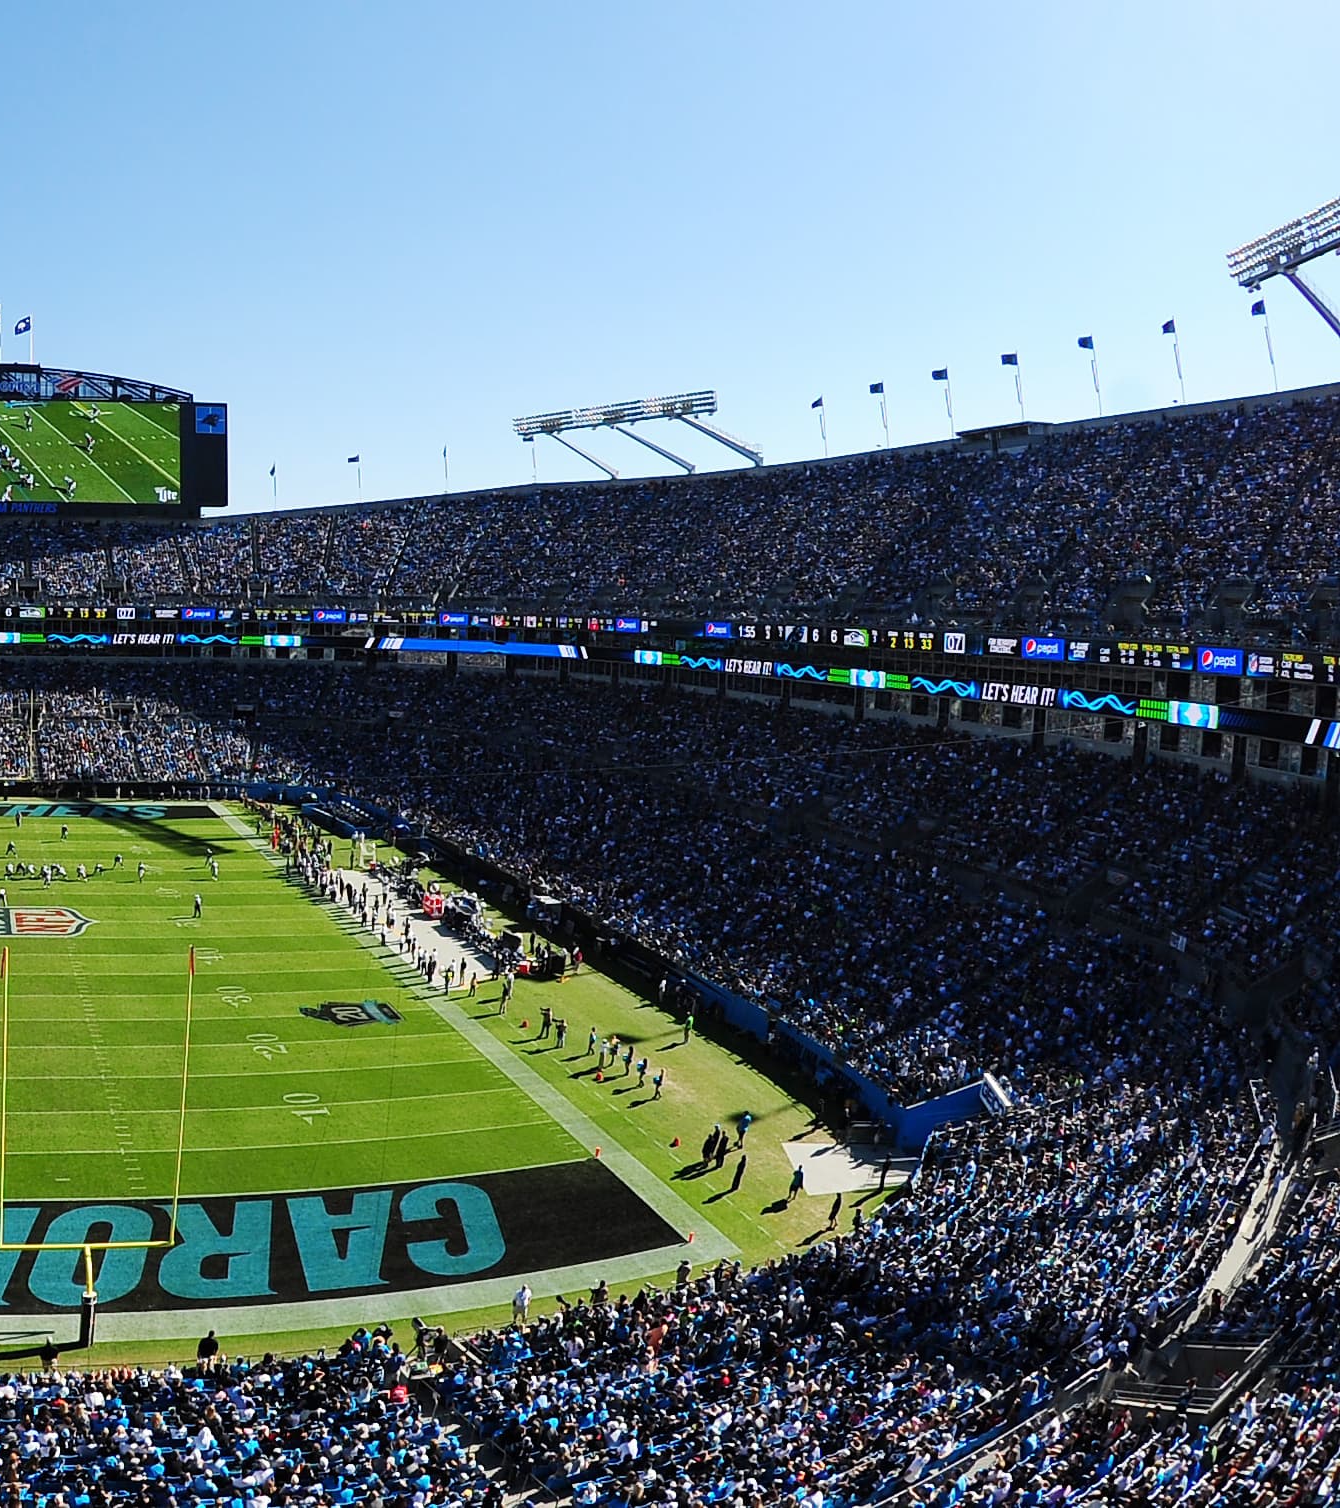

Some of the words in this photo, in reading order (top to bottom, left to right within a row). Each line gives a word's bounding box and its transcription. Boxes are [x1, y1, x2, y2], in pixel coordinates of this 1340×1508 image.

[10, 502, 58, 513] PANTHERS
[112, 633, 136, 645] LET'S
[137, 633, 161, 645] HEAR
[162, 633, 175, 645] IT!
[812, 628, 820, 642] 6
[830, 629, 838, 643] 6
[890, 637, 897, 649] 2
[947, 636, 961, 651] 07
[1036, 643, 1059, 656] pepsi
[1213, 655, 1236, 669] pepsi
[981, 682, 1010, 702] LET'S
[1010, 685, 1038, 704] HEAR
[1039, 687, 1056, 707] IT!
[246, 1033, 288, 1054] 20
[283, 1093, 331, 1116] 10
